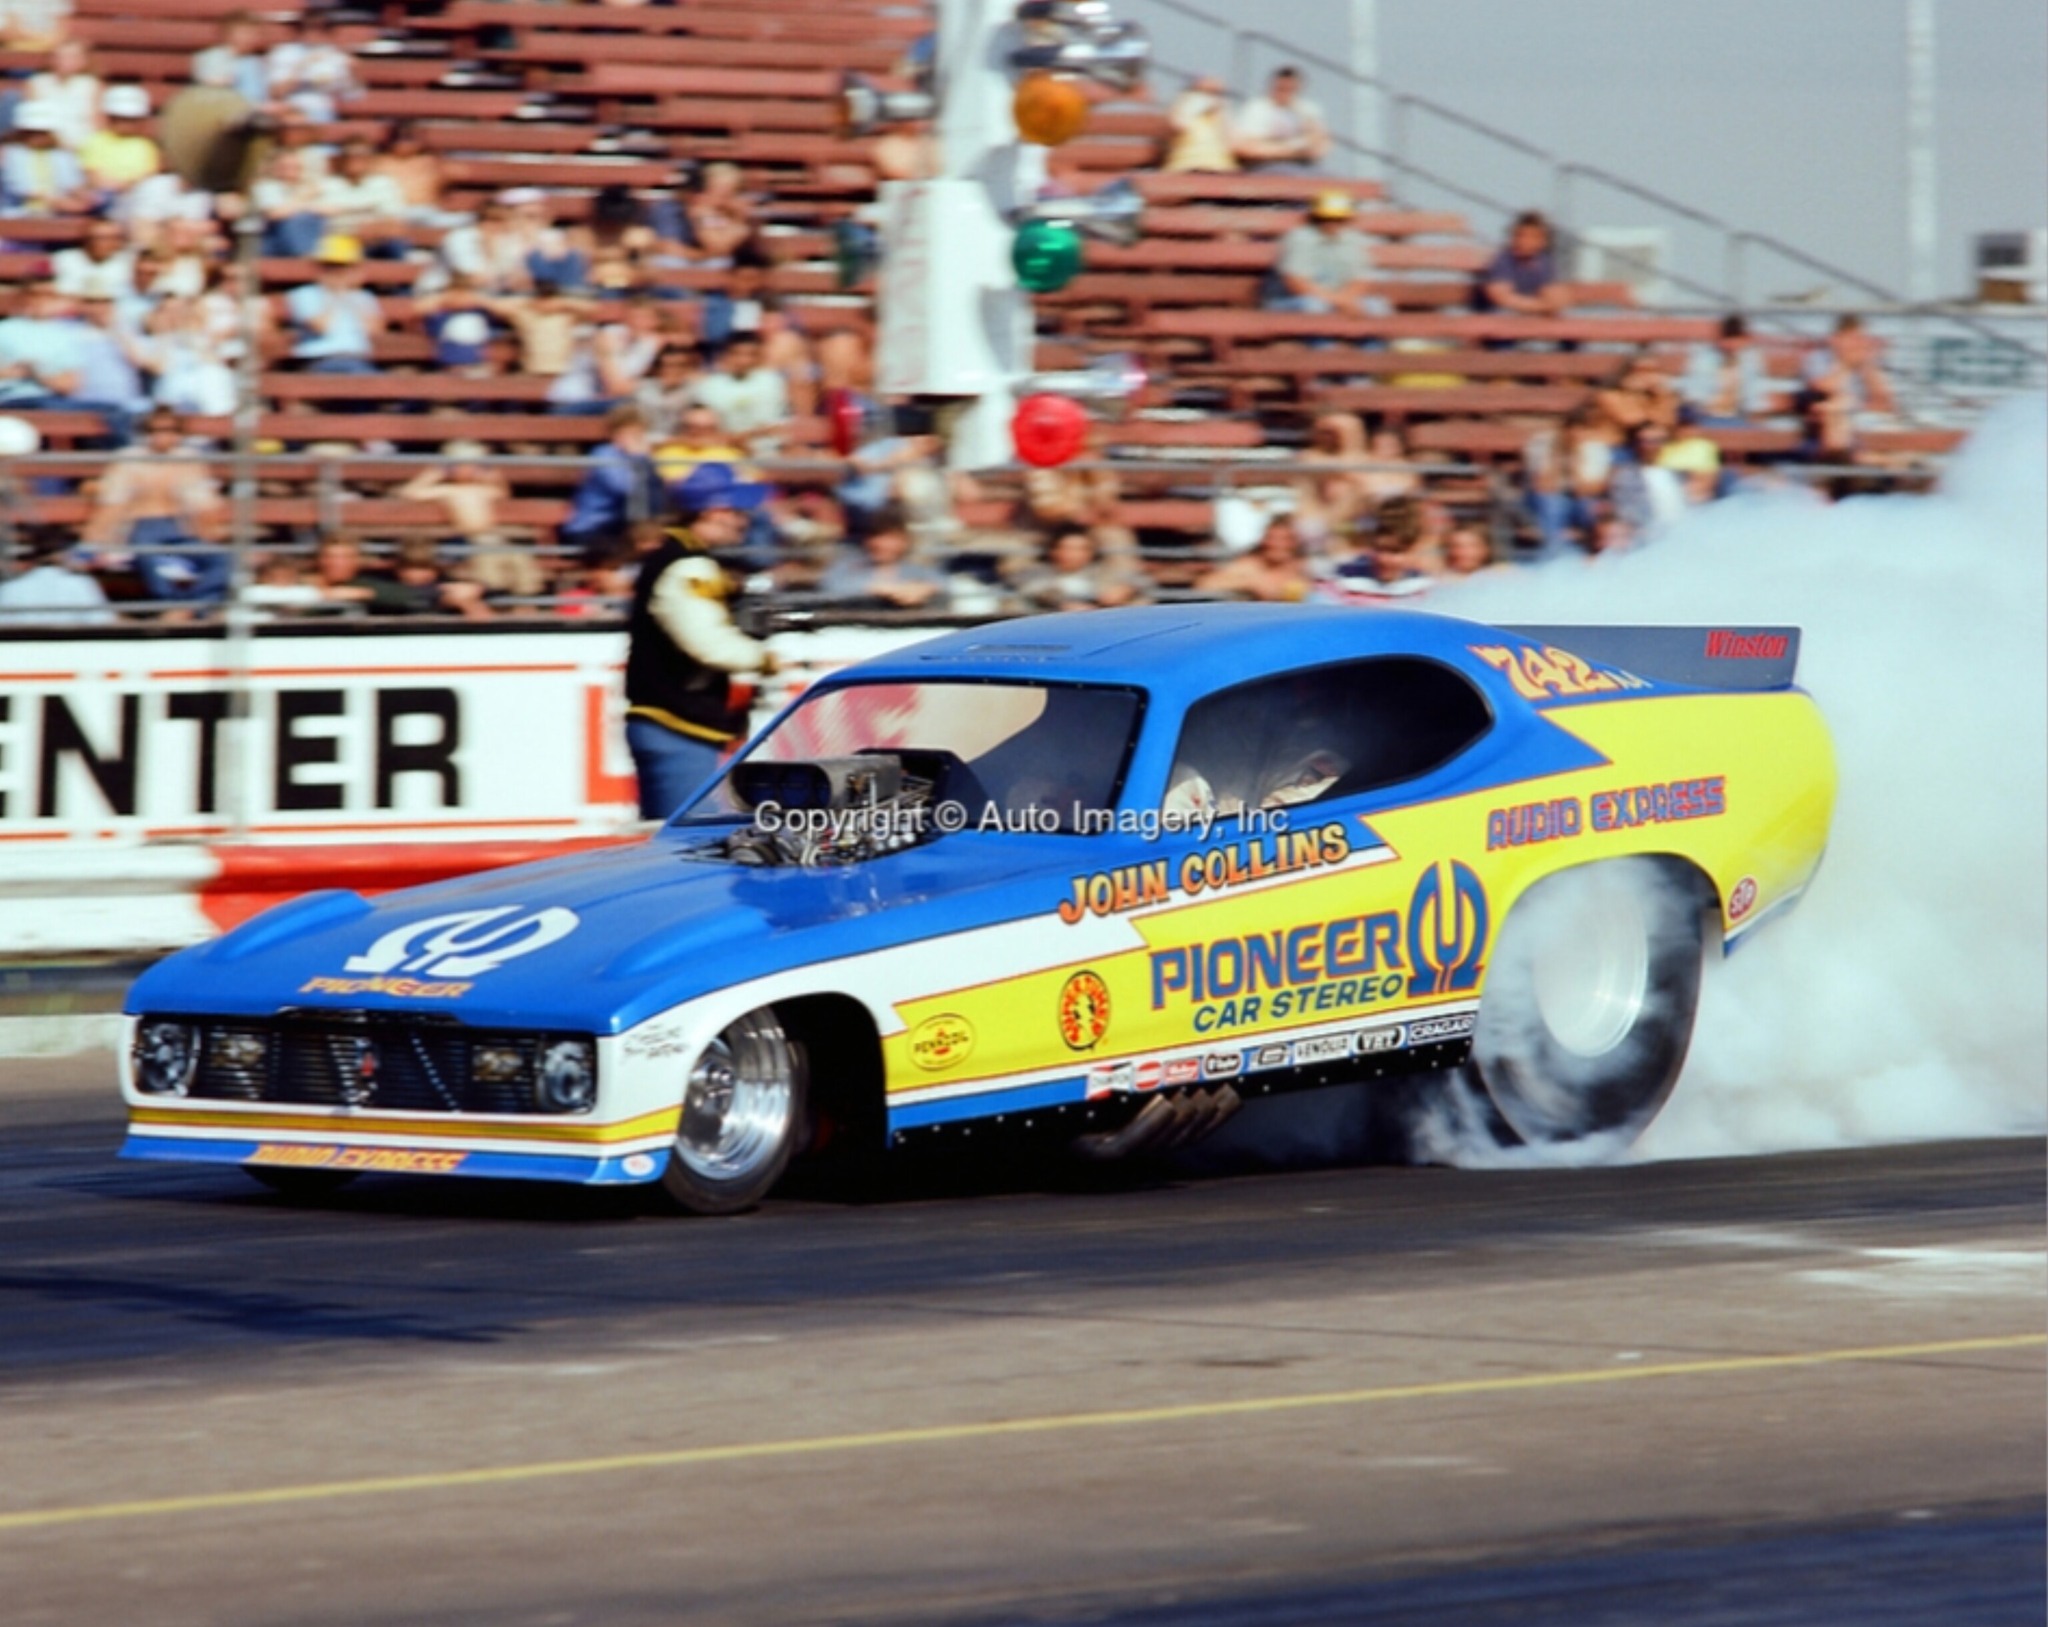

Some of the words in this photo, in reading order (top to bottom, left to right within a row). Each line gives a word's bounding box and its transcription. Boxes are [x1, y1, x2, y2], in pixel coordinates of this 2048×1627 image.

[1467, 644, 1622, 700] 742
[1704, 630, 1789, 660] Winston
[0, 687, 464, 822] NTER
[1486, 796, 1583, 852] AUDIO
[1590, 775, 1727, 833] EXPRESS
[1057, 858, 1171, 924] JOHN
[1180, 823, 1350, 896] COLLINS
[1148, 909, 1406, 1011] PIONEER
[1193, 996, 1263, 1033] CAR
[1270, 972, 1405, 1019] STEREO
